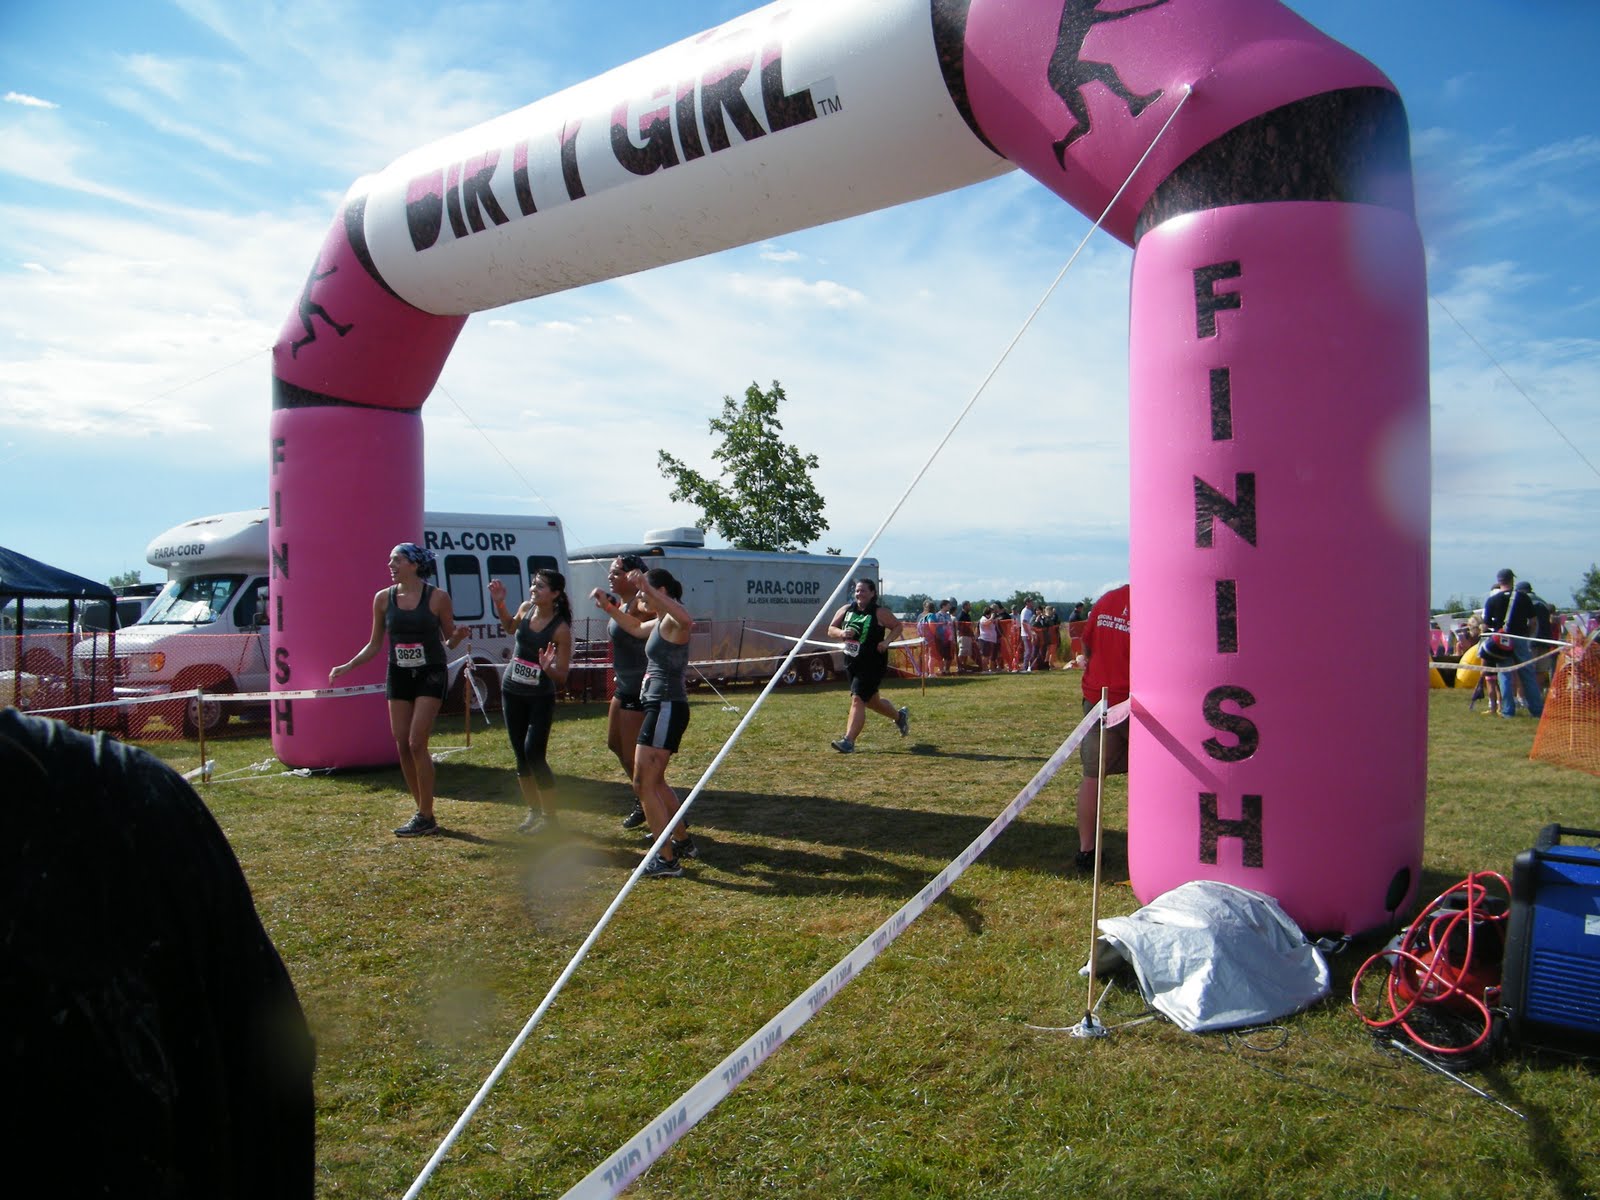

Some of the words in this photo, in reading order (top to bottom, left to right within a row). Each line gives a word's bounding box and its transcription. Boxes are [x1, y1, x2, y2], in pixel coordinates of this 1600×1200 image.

[405, 118, 588, 252] DIRTY
[609, 14, 818, 176] GIRL
[154, 543, 205, 560] PARA-CORP
[1193, 259, 1264, 869] FINISH
[272, 438, 294, 736] FINISH
[747, 580, 820, 595] PARA-CORP
[397, 648, 422, 660] 3623
[514, 663, 538, 679] 6894
